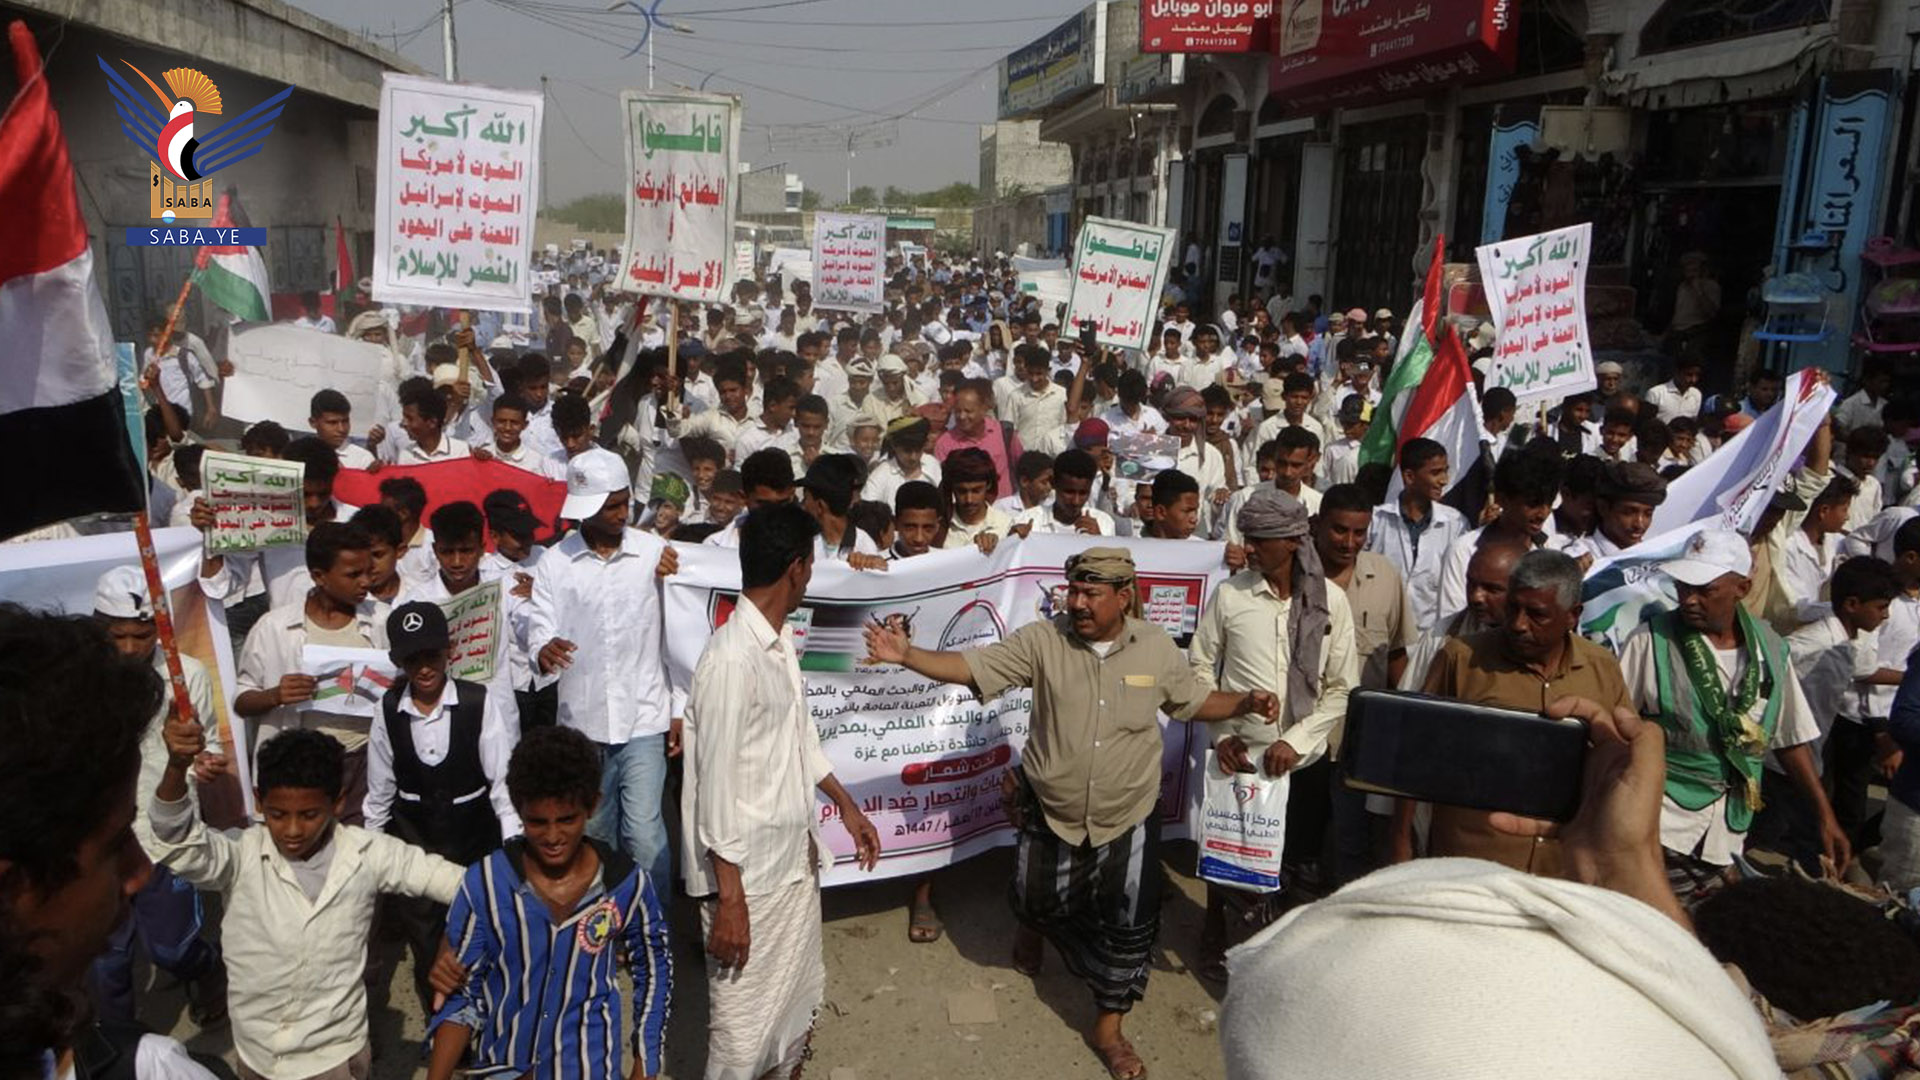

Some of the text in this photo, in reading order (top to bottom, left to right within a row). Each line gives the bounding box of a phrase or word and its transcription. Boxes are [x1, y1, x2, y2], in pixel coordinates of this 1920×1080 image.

[1151, 0, 1200, 17] موبايل
[1205, 0, 1249, 17] مروان
[1171, 21, 1252, 35] وكيل معتمد
[400, 104, 525, 145] الله أكبر
[638, 111, 722, 159] قاطعوا
[400, 147, 523, 182] الموت لأمريكا
[399, 180, 521, 214] الموت لإسرائيل
[679, 172, 725, 213] البضائع
[398, 217, 519, 246] اللعنة على اليهود
[857, 226, 877, 241] الله
[1085, 230, 1159, 262] قاطعوا
[397, 247, 518, 287] النصر للإسلام
[1500, 234, 1577, 280] الله أكبر
[1544, 270, 1574, 294] الموت
[1544, 351, 1582, 385] النصر
[210, 469, 295, 487] الله أكبر
[842, 685, 886, 700] العلمي
[811, 702, 860, 719] بالمديرية
[854, 746, 877, 762] غزة
[881, 747, 899, 762] مع
[902, 740, 945, 755] تضامنا
[924, 759, 969, 782] شعار
[888, 790, 918, 810] ضد
[1252, 811, 1280, 827] مركز
